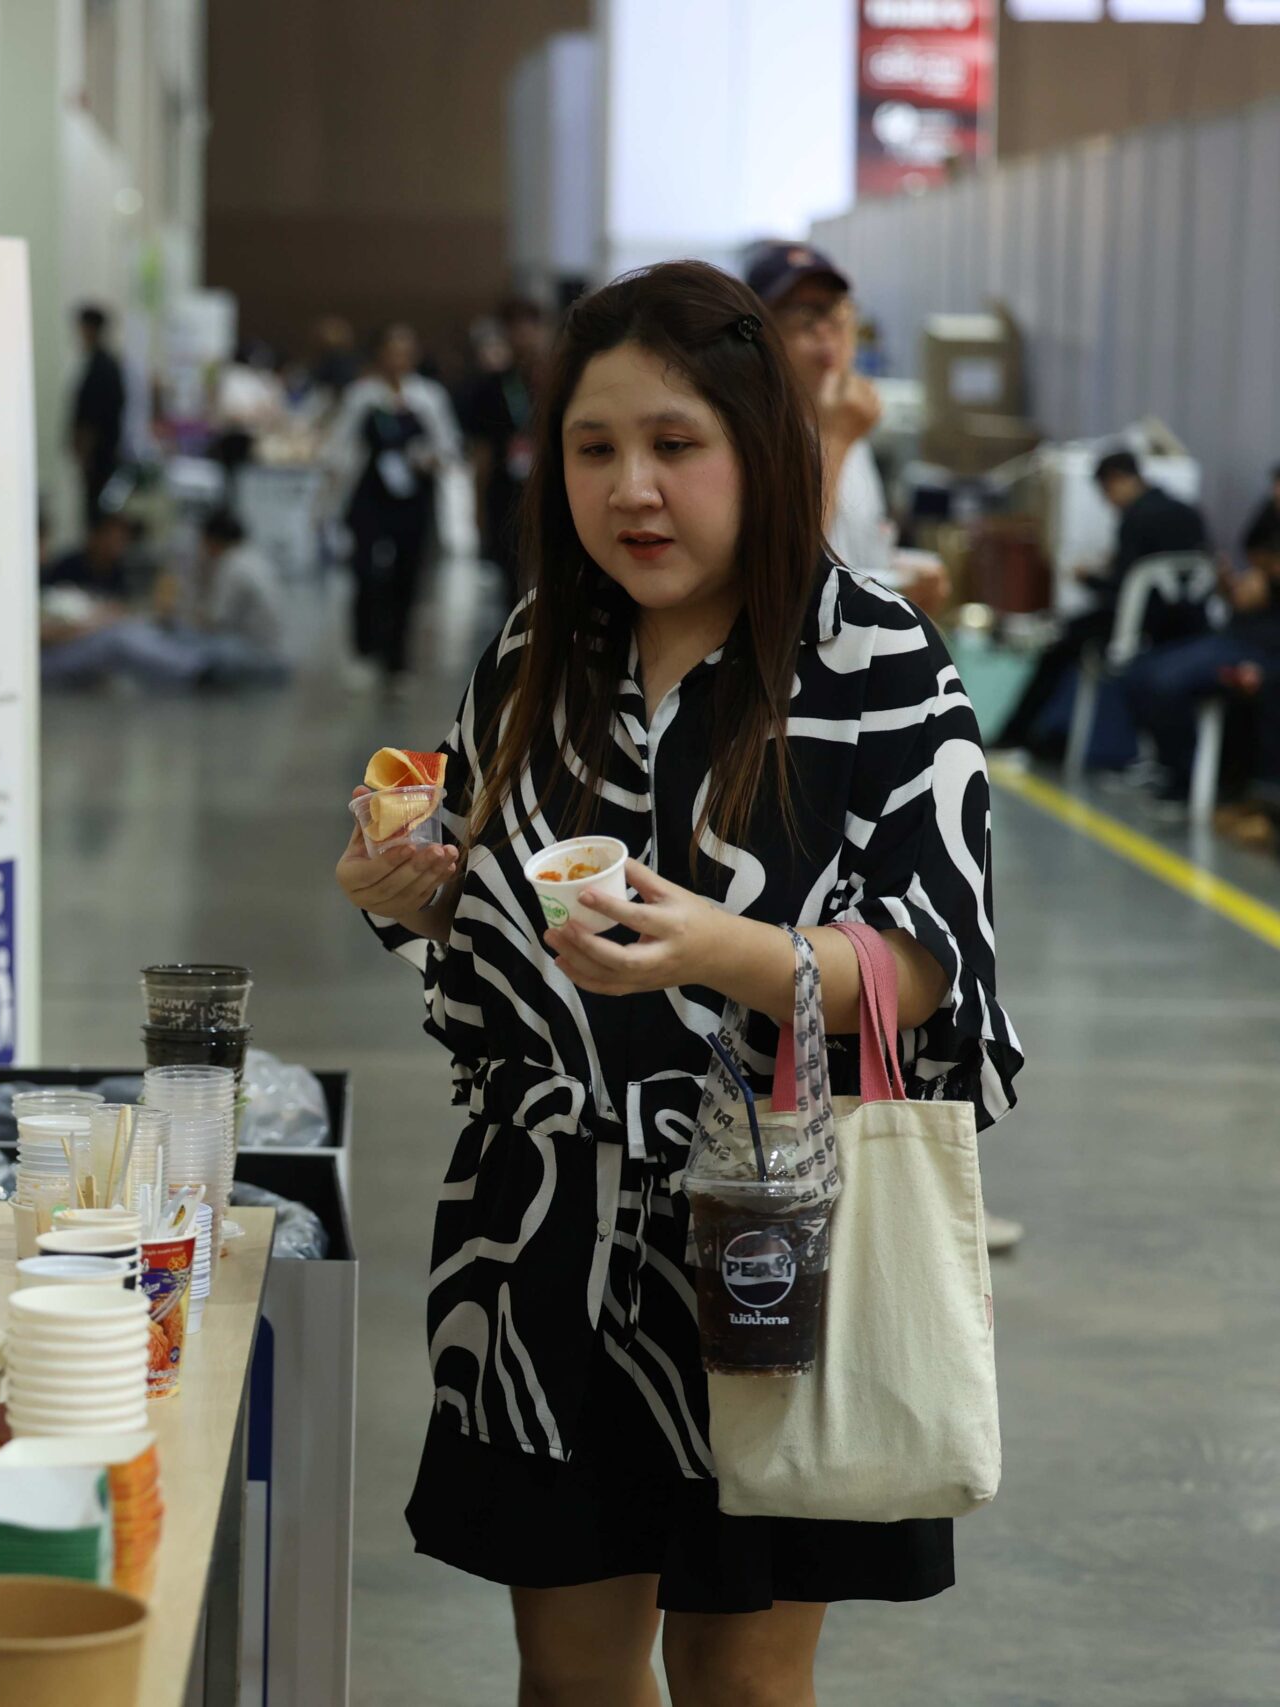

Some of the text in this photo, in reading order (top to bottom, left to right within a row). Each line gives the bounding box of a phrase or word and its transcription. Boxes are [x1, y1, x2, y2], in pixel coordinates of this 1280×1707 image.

[728, 1309, 790, 1325] ไม่มีน้ำตาล
